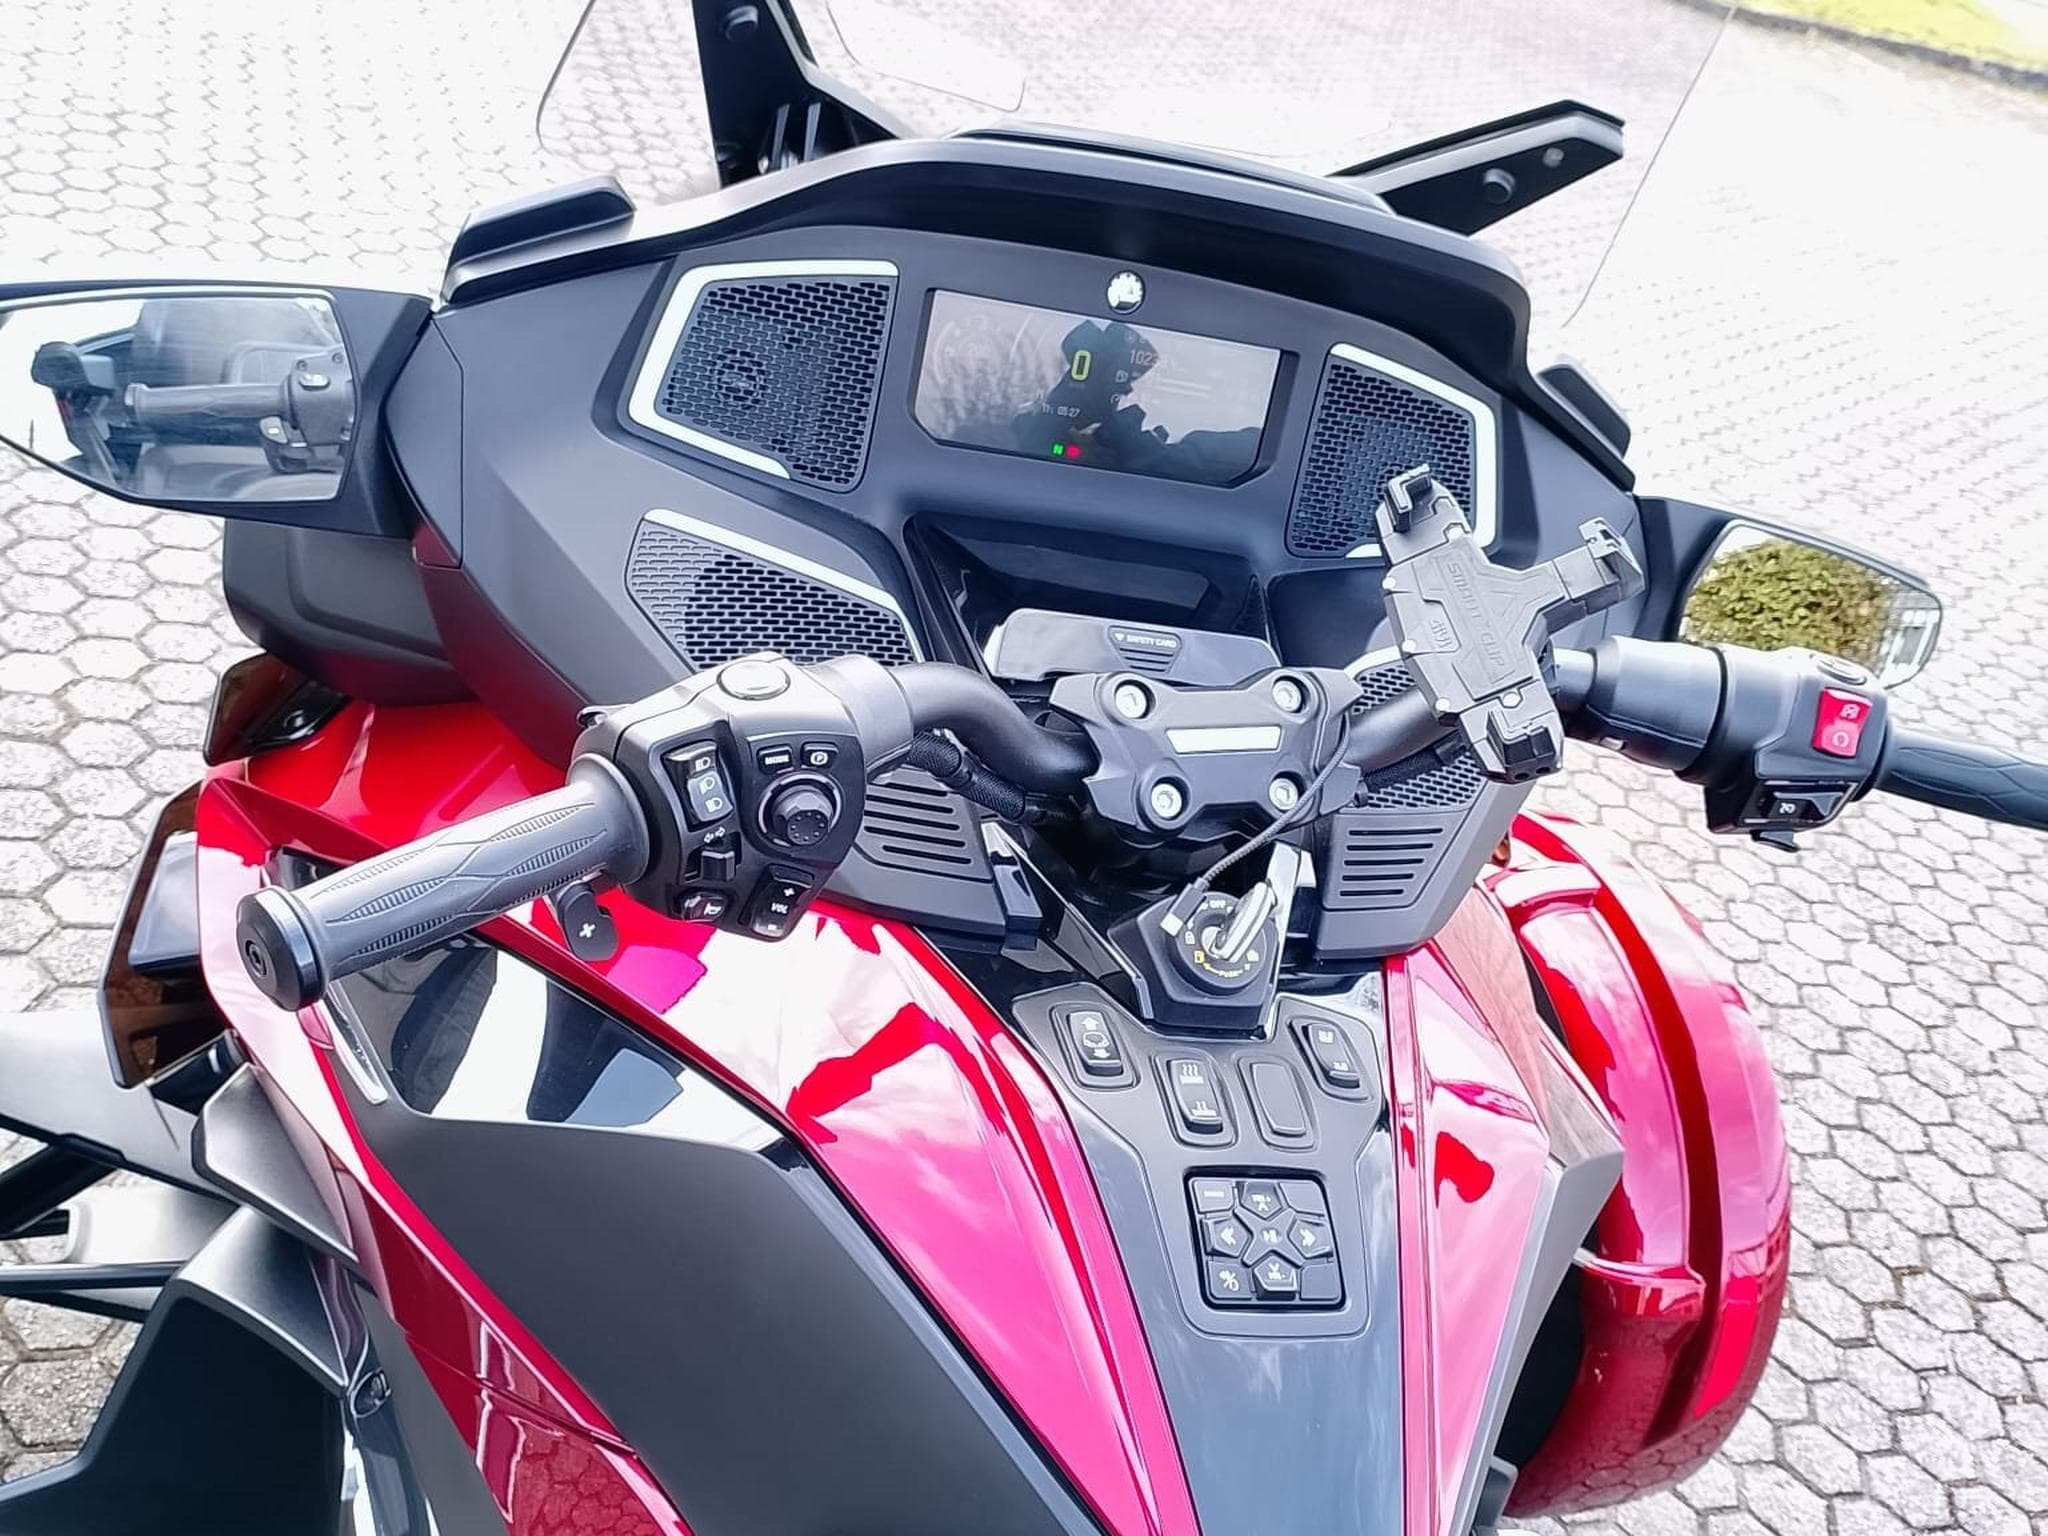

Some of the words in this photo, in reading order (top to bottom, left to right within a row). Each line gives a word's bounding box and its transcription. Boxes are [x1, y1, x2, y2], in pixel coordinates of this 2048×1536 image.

[1071, 350, 1092, 381] 0
[1126, 634, 1154, 645] SAFETY
[1155, 639, 1177, 648] CARD
